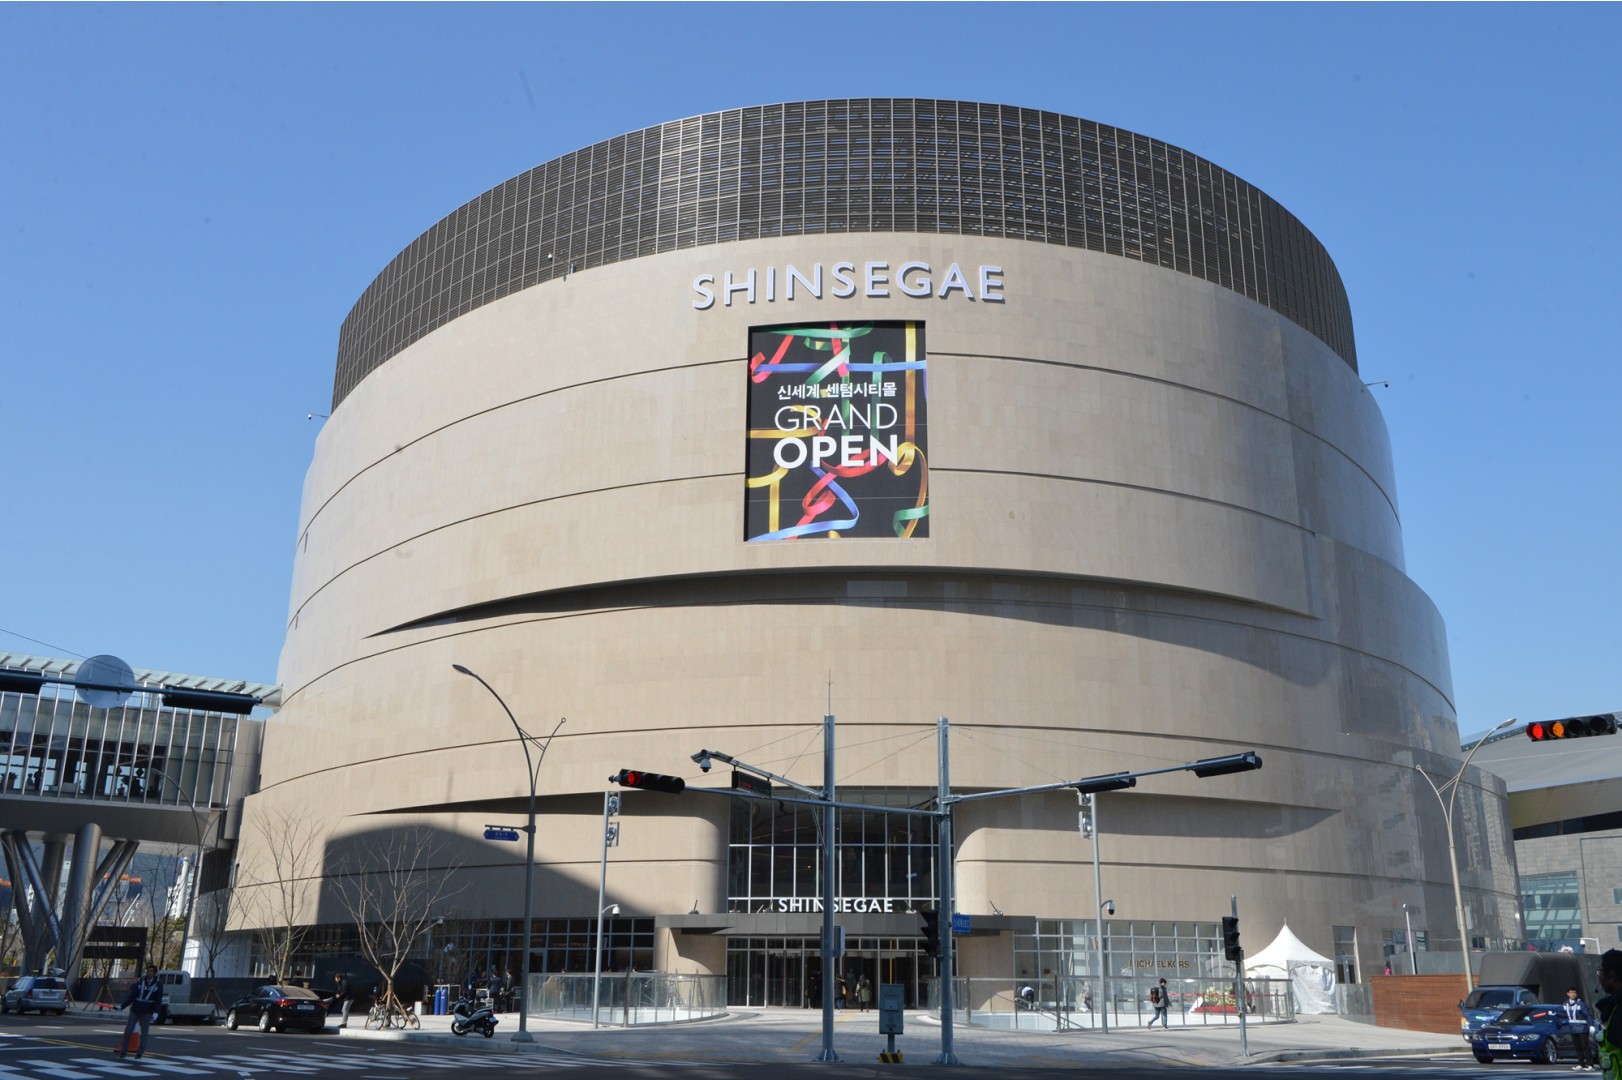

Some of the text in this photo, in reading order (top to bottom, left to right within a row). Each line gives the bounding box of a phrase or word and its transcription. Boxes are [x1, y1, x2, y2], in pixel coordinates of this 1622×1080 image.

[692, 261, 1005, 309] SHINSEGAE
[777, 382, 897, 400] 신세계 센텀시티몰
[774, 403, 898, 432] GRAND
[773, 434, 898, 469] OPEN
[778, 898, 893, 913] SHINSEGAE
